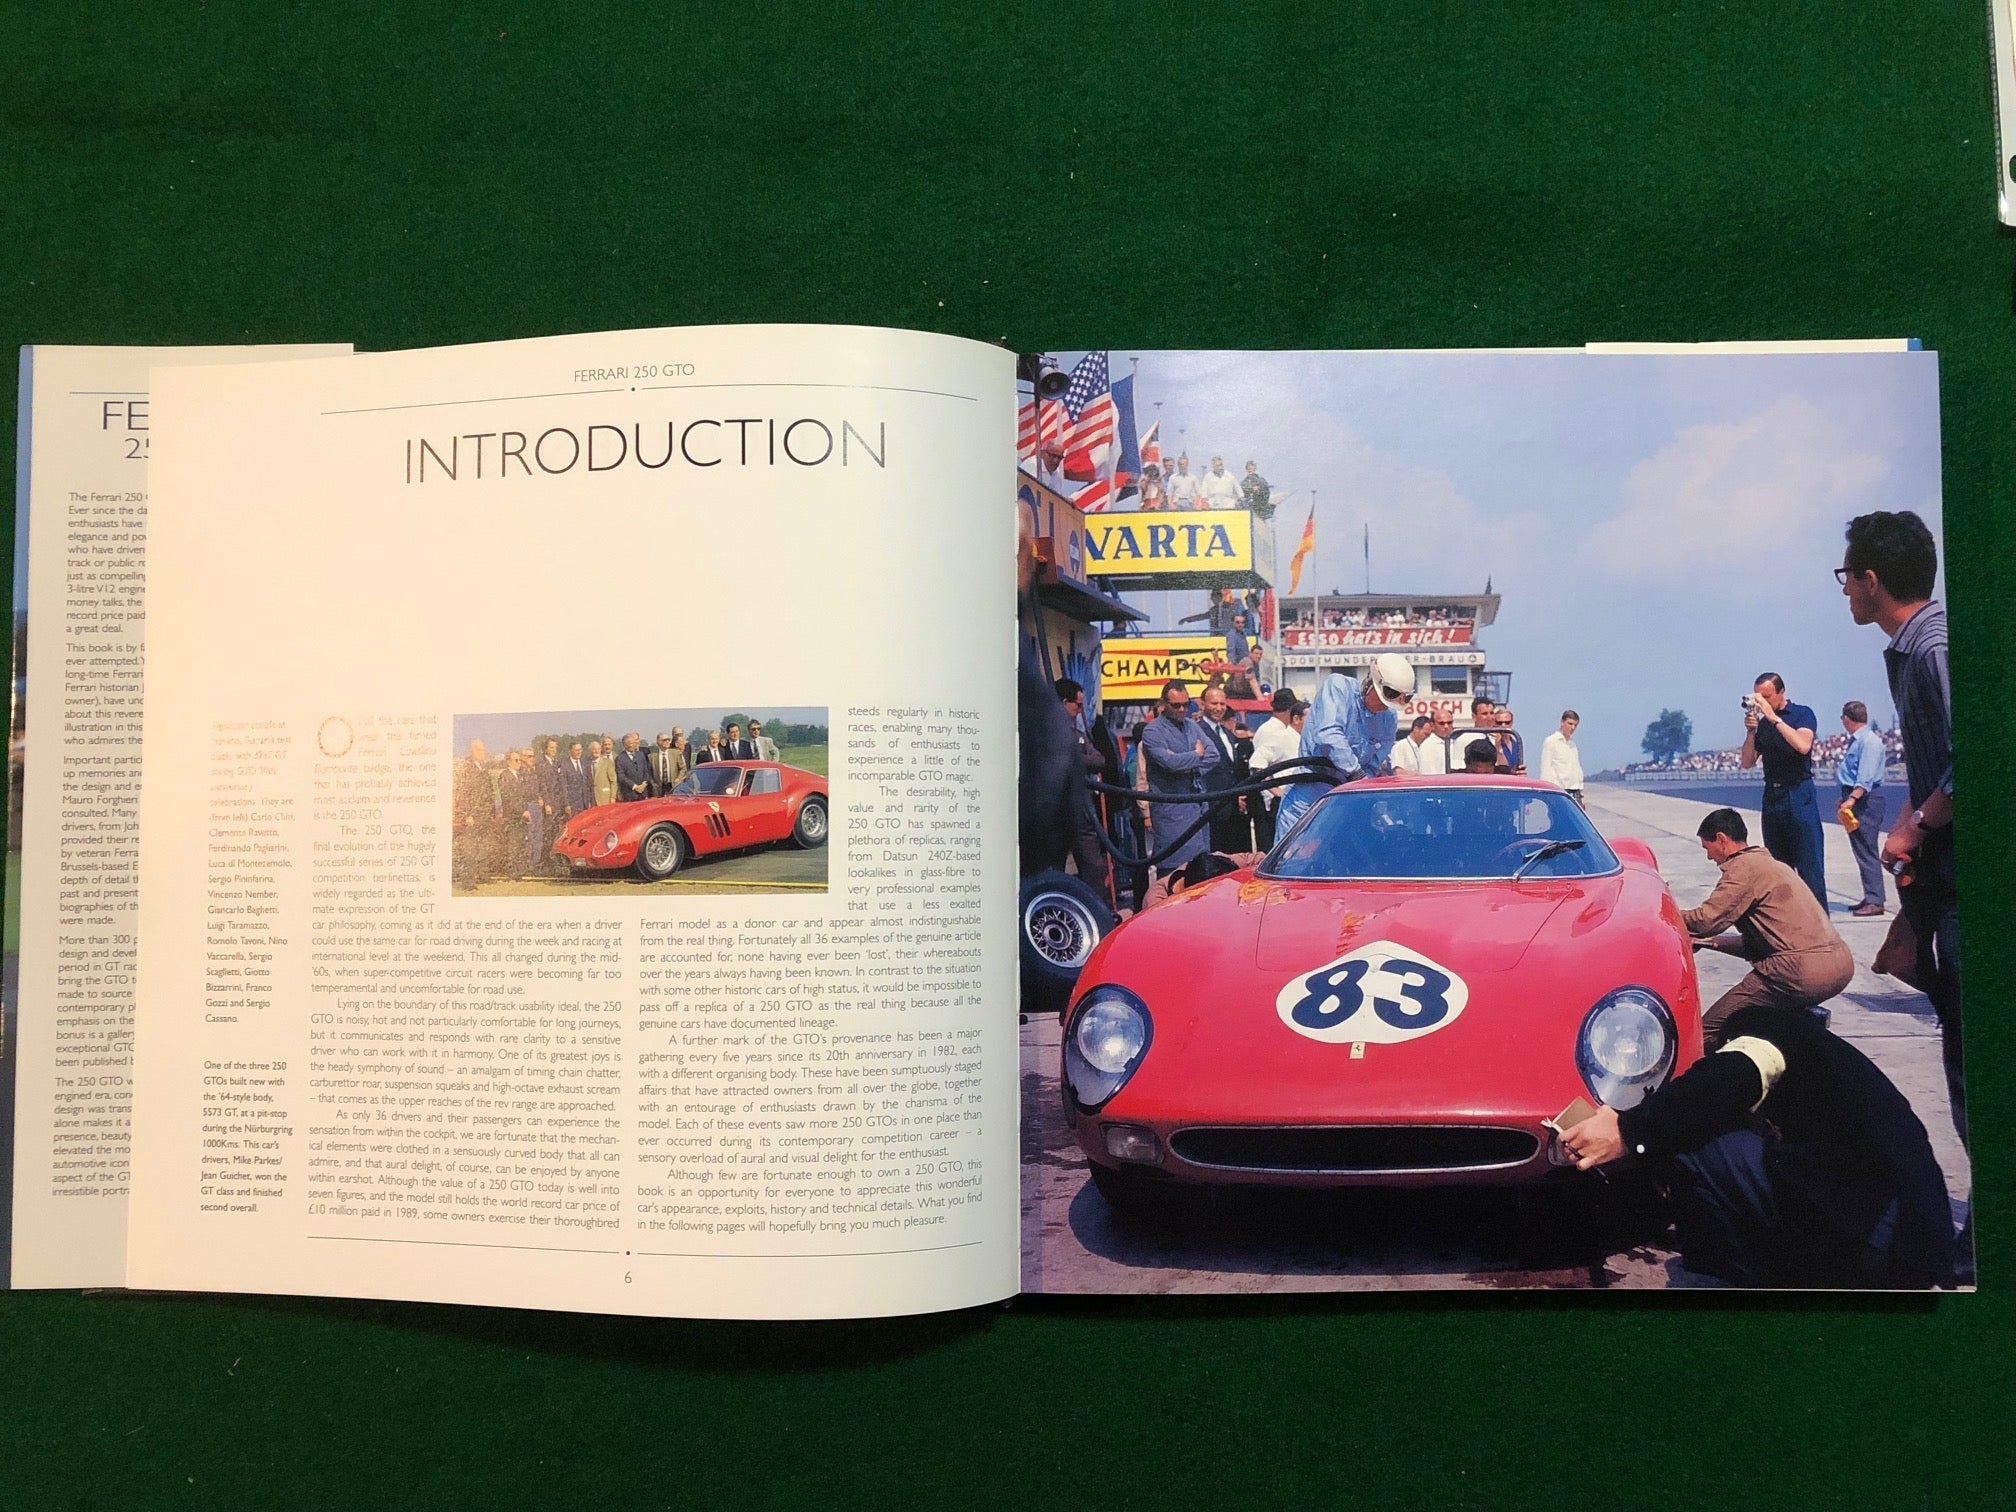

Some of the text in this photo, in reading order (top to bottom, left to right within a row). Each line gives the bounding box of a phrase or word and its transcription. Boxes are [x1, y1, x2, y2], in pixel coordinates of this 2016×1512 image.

[574, 363, 695, 382] FERRARI 250 GTO
[406, 418, 885, 484] INTRODUCTION
[70, 492, 143, 502] The Ferrari 250
[69, 505, 90, 515] Ever
[118, 506, 134, 515] the
[68, 519, 143, 528] enthusiasts have
[1085, 524, 1237, 561] VARTA
[68, 545, 145, 554] who have driven
[66, 610, 145, 622] record price paid
[75, 625, 99, 636] great
[102, 624, 123, 633] deal.
[1385, 629, 1402, 645] in
[1290, 655, 1376, 665] DORMUNDER
[65, 682, 139, 692] Ferrari historian
[848, 706, 980, 721] steeds regularly in historic
[1404, 700, 1463, 715] BOSCH
[848, 722, 980, 737] races, enabling many thou-
[848, 737, 980, 751] sands of enthusiasts to
[848, 754, 980, 767] experience a little of the
[848, 769, 974, 785] incomparable GTO magic.
[208, 890, 243, 899] Vincenzo
[207, 905, 244, 914] Giancarlo
[59, 915, 116, 925] were made.
[59, 934, 130, 945] More than 300
[207, 936, 238, 945] Romolo
[268, 936, 288, 945] Nino
[246, 982, 272, 992] Franco
[311, 982, 525, 995] temperamental and uncomfortable for road use.
[1291, 958, 1452, 1030] 83
[206, 998, 270, 1010] Gozzi and Sergio
[204, 1060, 287, 1071] One of the three 250
[55, 1076, 123, 1087] The 250 GTO
[203, 1076, 227, 1086] GTOs
[230, 1076, 247, 1086] built
[268, 1077, 285, 1086] with
[203, 1092, 216, 1101] the
[253, 1092, 274, 1104] body,
[203, 1107, 222, 1117] 5573
[257, 1110, 287, 1120] pit-stop
[202, 1124, 293, 1136] during the Nürburgring
[243, 1139, 260, 1149] This
[202, 1155, 230, 1165] drivers,
[233, 1155, 252, 1165] Mike
[201, 1171, 217, 1182] Jean
[274, 1172, 287, 1181] the
[667, 1160, 982, 1183] Although few are fortunate enough to own a 250 GTO, this
[201, 1186, 283, 1197] GT class and finished
[201, 1203, 228, 1212] second
[329, 1205, 358, 1216] million
[361, 1206, 380, 1219] paid
[383, 1209, 392, 1217] in
[397, 1207, 420, 1219] 1989,
[423, 1211, 448, 1220] some
[451, 1212, 485, 1222] owners
[488, 1214, 526, 1224] exercise
[529, 1214, 551, 1225] their
[554, 1215, 620, 1231] thoroughbred
[638, 1215, 947, 1235] in the following pages will hopefully bring you much pleasure.
[624, 1270, 633, 1284] 6
